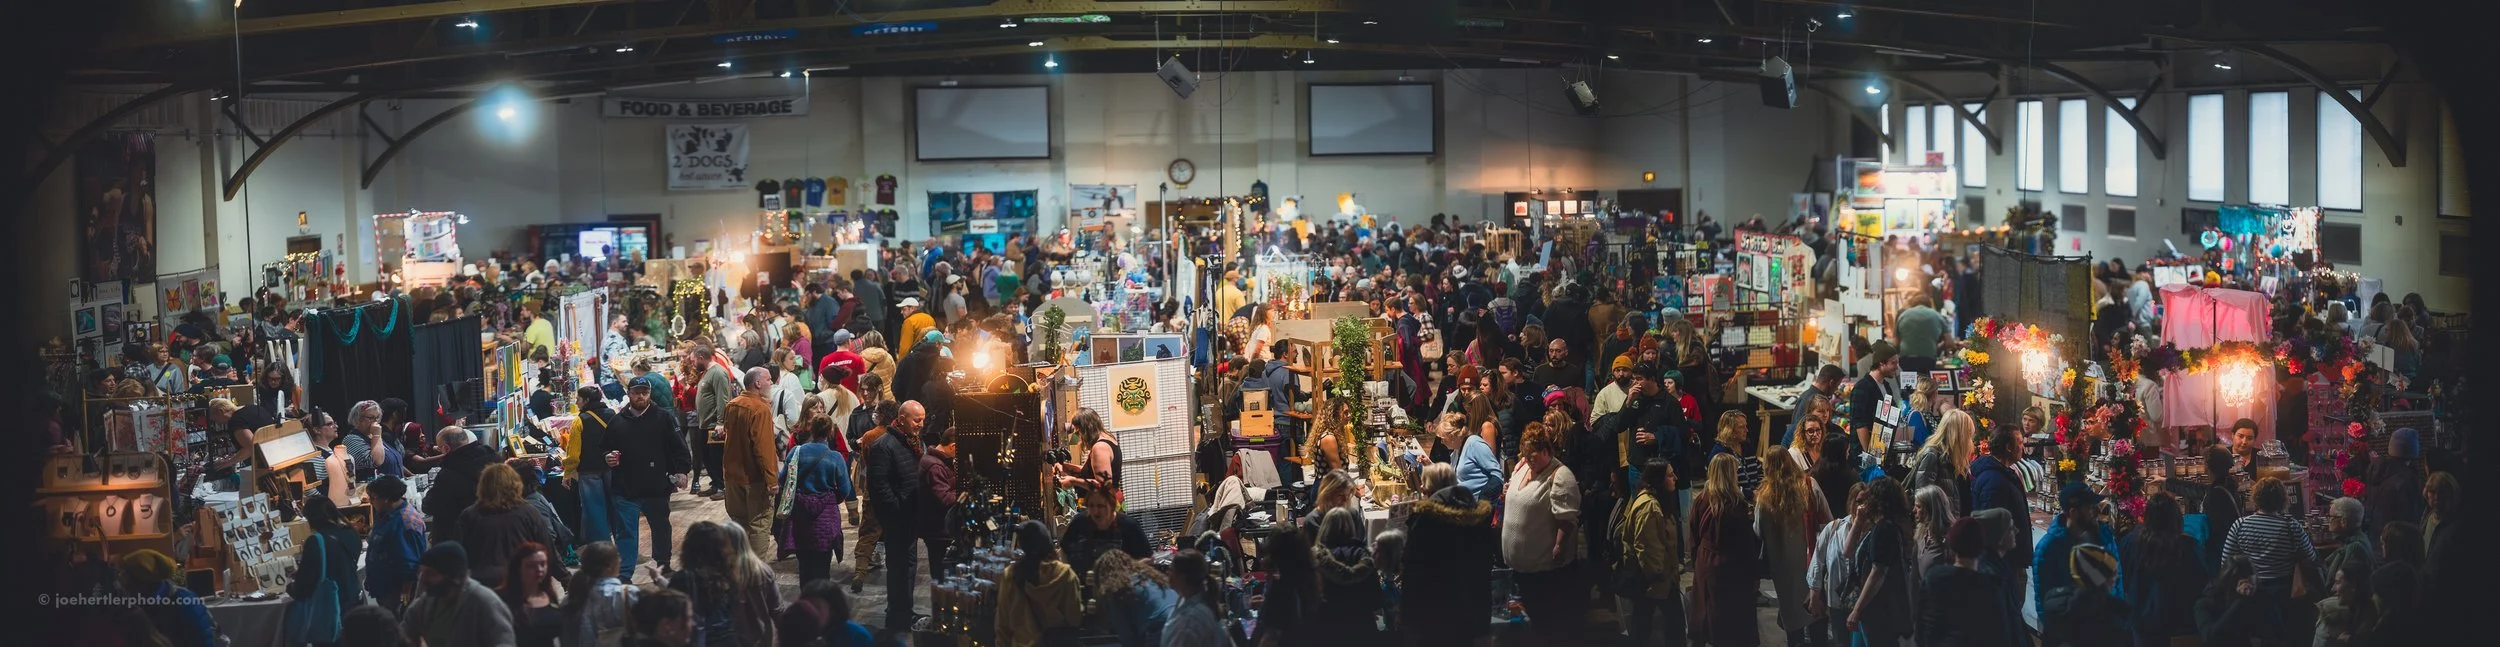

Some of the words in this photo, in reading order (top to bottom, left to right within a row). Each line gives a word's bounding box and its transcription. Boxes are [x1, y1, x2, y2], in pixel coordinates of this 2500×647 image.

[620, 101, 673, 116] FOOD
[677, 101, 692, 116] &
[697, 99, 793, 117] BEVERAGE
[672, 155, 683, 168] 2
[687, 154, 733, 168] DOGS
